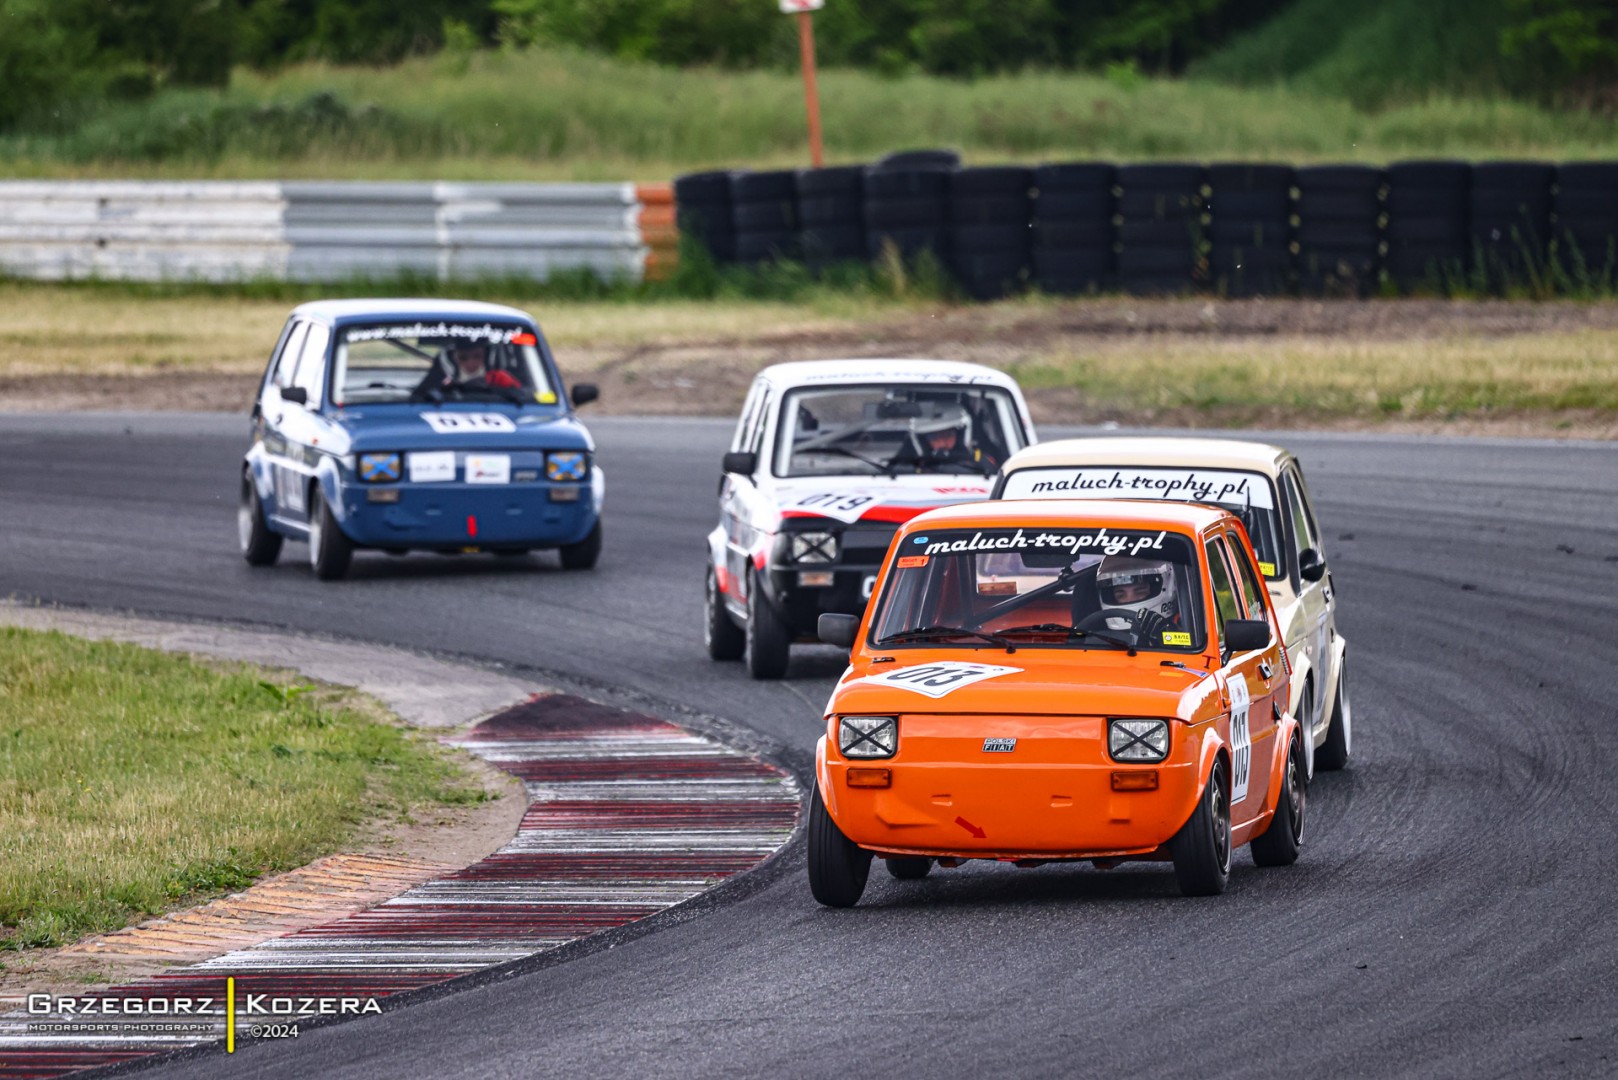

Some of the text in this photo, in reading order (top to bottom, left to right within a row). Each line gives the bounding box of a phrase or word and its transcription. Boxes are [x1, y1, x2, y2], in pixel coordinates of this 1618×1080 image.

[1031, 472, 1248, 500] maluch-trophy.pl
[797, 493, 874, 511] 019
[924, 528, 1165, 555] maluch-trophy.pl
[886, 665, 985, 687] 013
